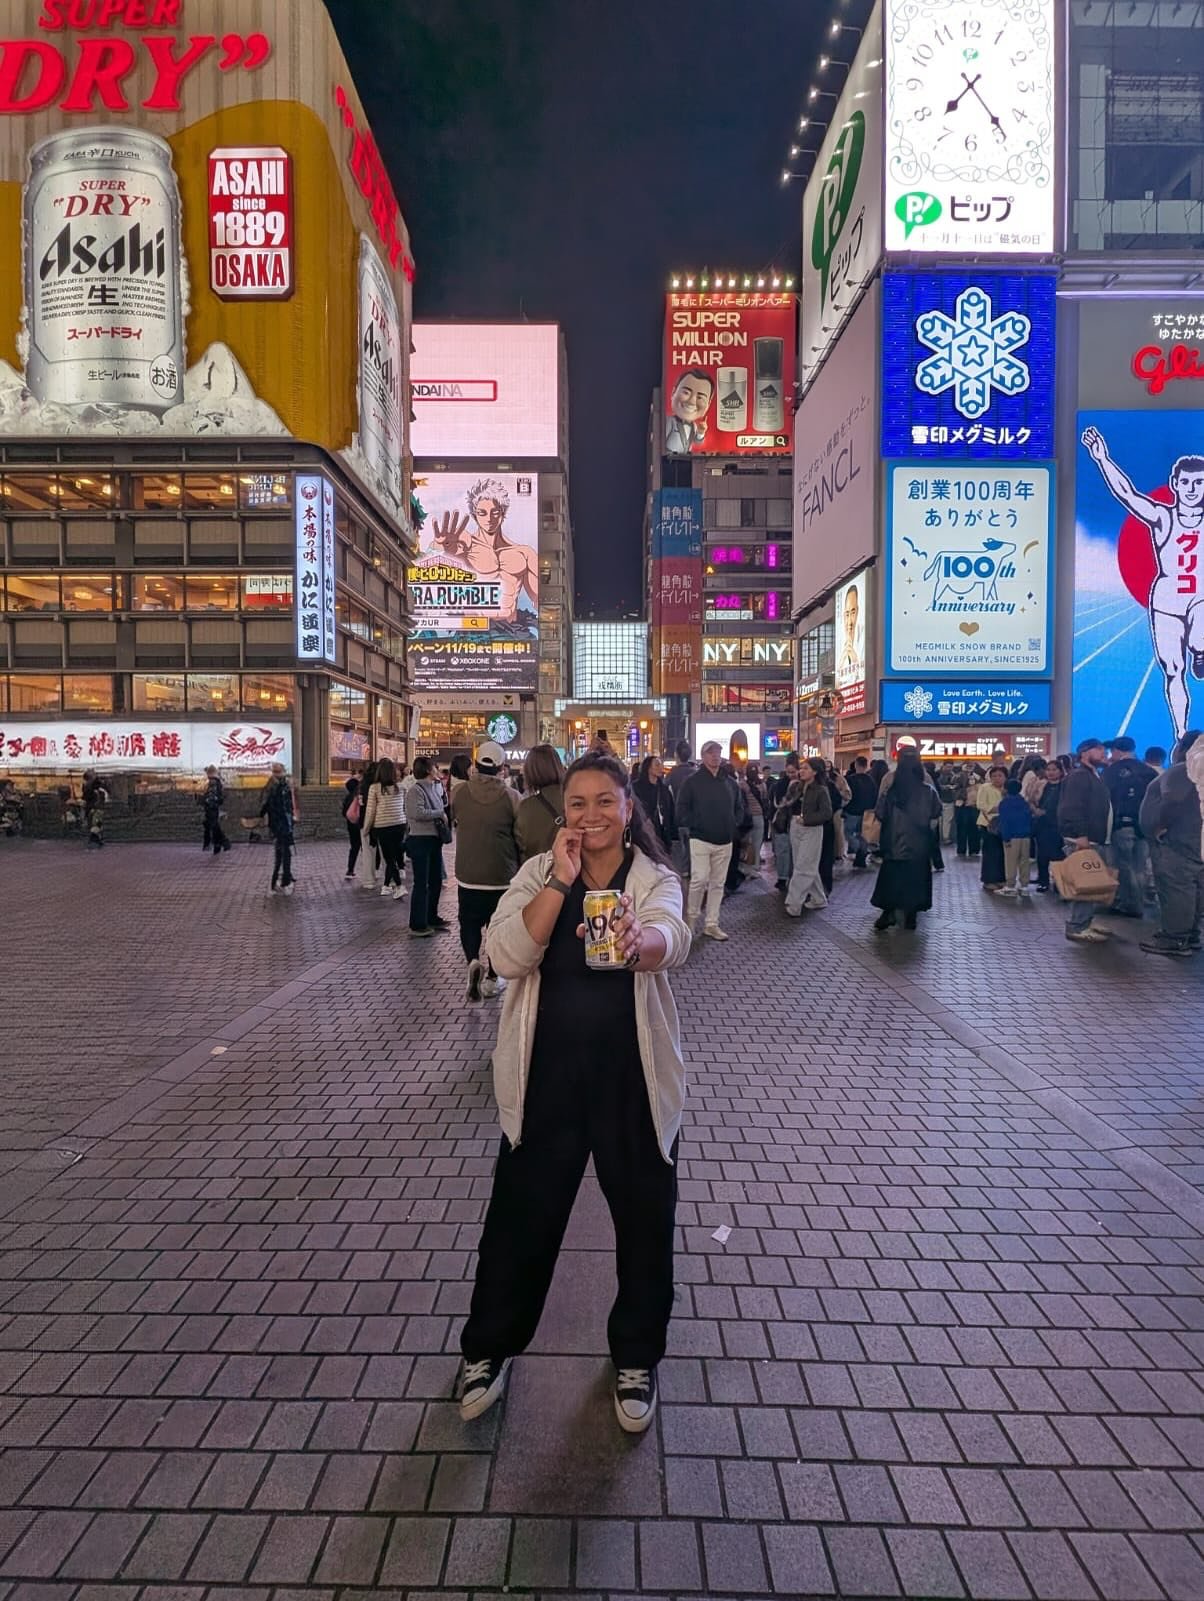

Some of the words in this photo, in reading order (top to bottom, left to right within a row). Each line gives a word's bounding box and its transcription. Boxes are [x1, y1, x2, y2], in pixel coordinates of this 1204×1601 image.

[39, 0, 182, 29] SUPER
[934, 24, 953, 46] 11
[962, 20, 982, 38] 12
[994, 30, 1004, 45] 1
[912, 44, 934, 67] 10
[1010, 51, 1027, 67] 2
[905, 77, 924, 91] 9
[1017, 80, 1035, 93] 3
[914, 106, 932, 122] 8
[1011, 107, 1028, 123] 4
[937, 126, 954, 142] 7
[964, 133, 978, 152] 6
[80, 180, 126, 191] SUPER
[213, 161, 284, 197] ASAHI
[232, 197, 267, 211] since
[950, 194, 1014, 222] ピップ
[212, 211, 286, 248] 1889
[40, 222, 165, 281] Asahi
[830, 205, 865, 301] ピップ
[215, 252, 286, 288] OSAKA
[87, 284, 120, 306] 生
[673, 312, 740, 328] SUPER
[67, 326, 143, 340] スーパードライ
[672, 332, 748, 347] MILLION
[672, 351, 723, 366] HAIR
[152, 362, 177, 390] お酒
[1134, 345, 1204, 394] Gli
[740, 437, 768, 445] ルアン
[911, 424, 1031, 444] 雪印メグミルク
[802, 439, 861, 533] FANCL
[908, 479, 1035, 501] 創業100周年
[924, 508, 1018, 528] ありがとう
[302, 505, 318, 564] 本場の味
[944, 556, 1017, 578] 100th
[1175, 530, 1201, 595] グリコ
[437, 586, 499, 605] RUMBLE
[301, 570, 320, 653] かに道楽
[925, 600, 1016, 615] Anniversary
[703, 643, 738, 661] NY
[754, 643, 788, 661] NY
[915, 643, 957, 651] MEGMILK
[959, 643, 986, 651] SNOW
[990, 643, 1022, 651] BRAND
[943, 689, 960, 697] Love
[962, 689, 985, 697] Earth.
[988, 689, 1005, 697] Love
[1007, 689, 1023, 697] Life.
[938, 699, 1029, 716] 雪印メグミルク
[504, 750, 530, 760] TAY
[920, 739, 1006, 755] ZETTERIA
[1081, 861, 1101, 872] GU
